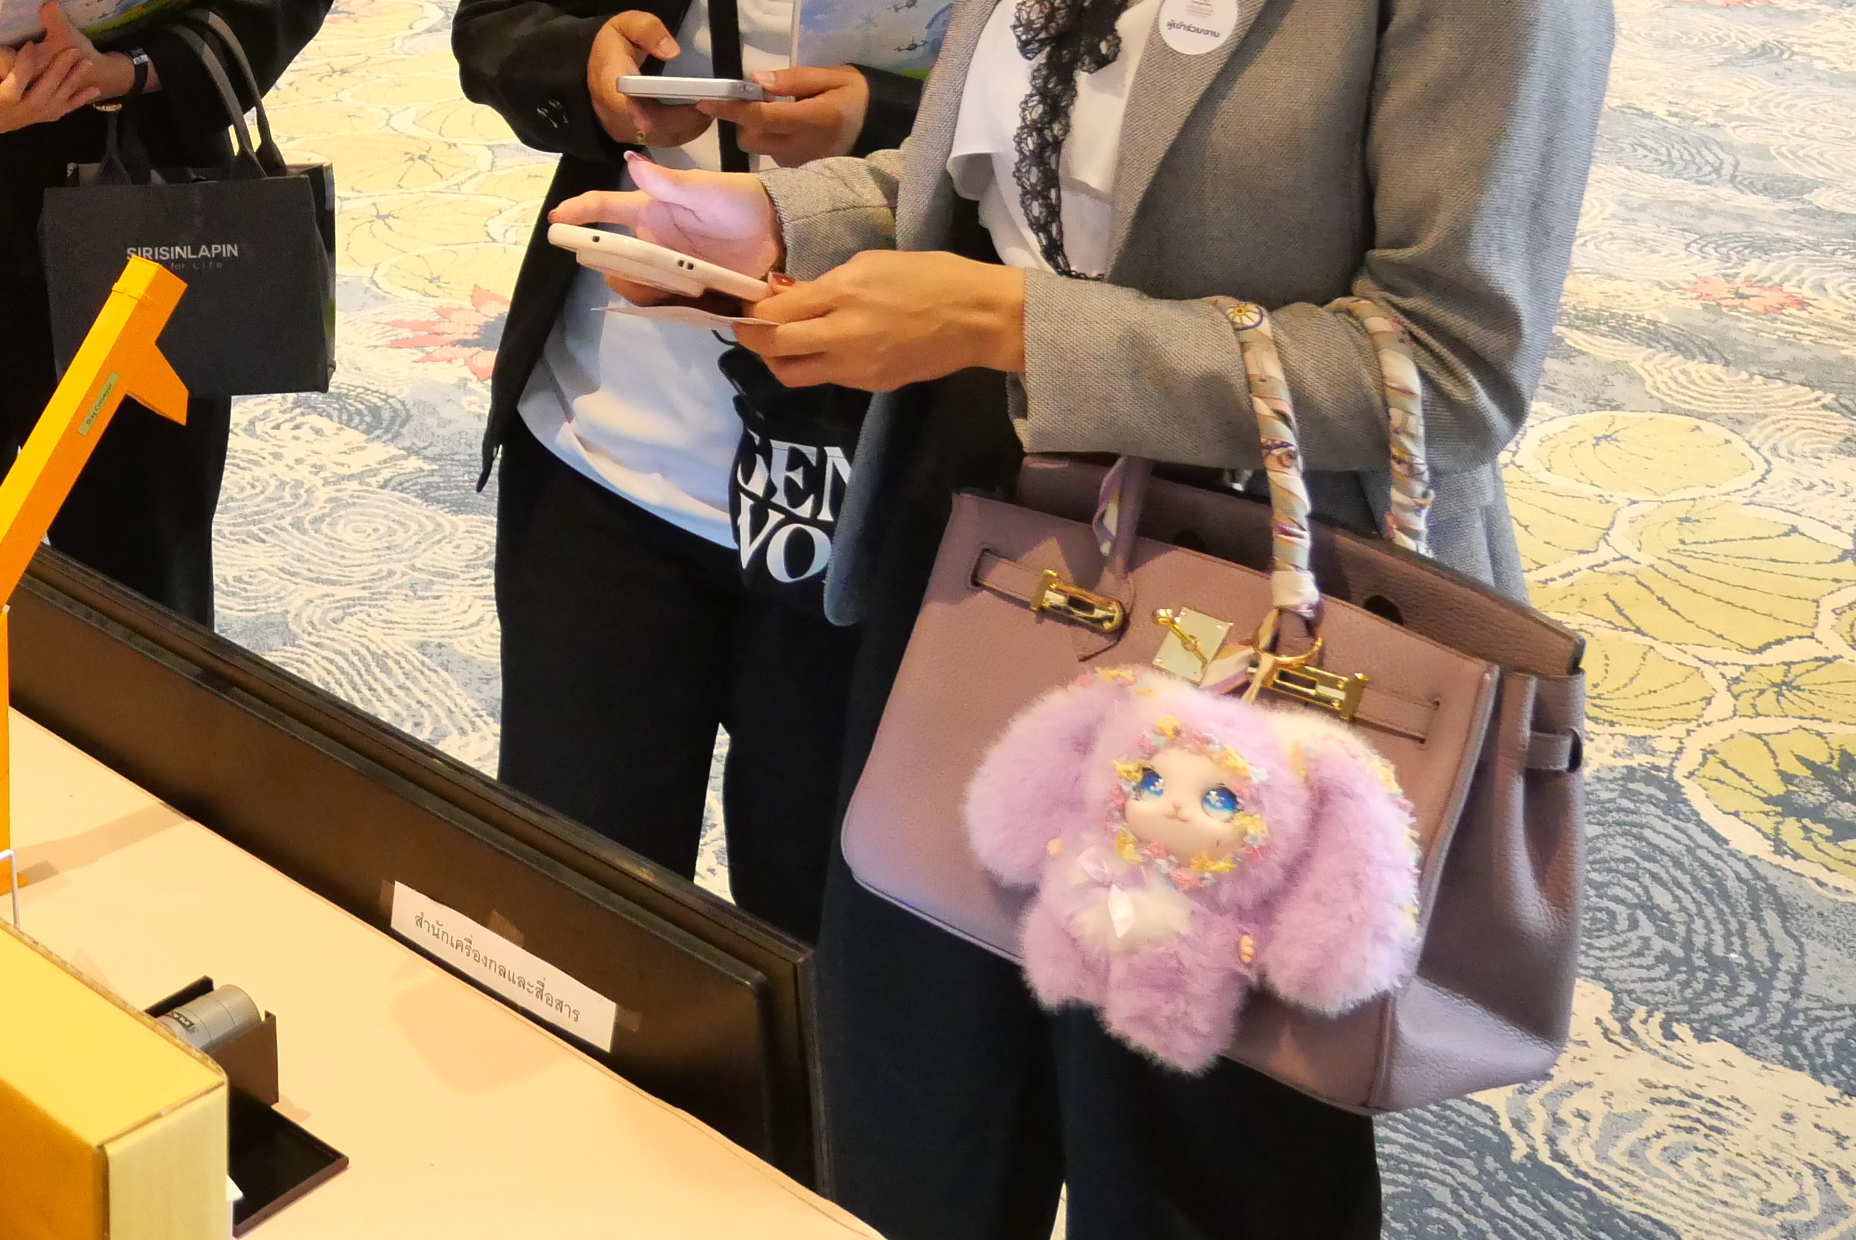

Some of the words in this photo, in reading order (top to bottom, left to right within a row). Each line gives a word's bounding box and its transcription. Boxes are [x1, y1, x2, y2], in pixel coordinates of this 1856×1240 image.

[1166, 18, 1221, 39] ผู้เข้าร่วมงาน
[126, 243, 239, 261] SIRISINLAPIN
[414, 912, 581, 1022] สำนักเครื่องกลและสื่อสาร
